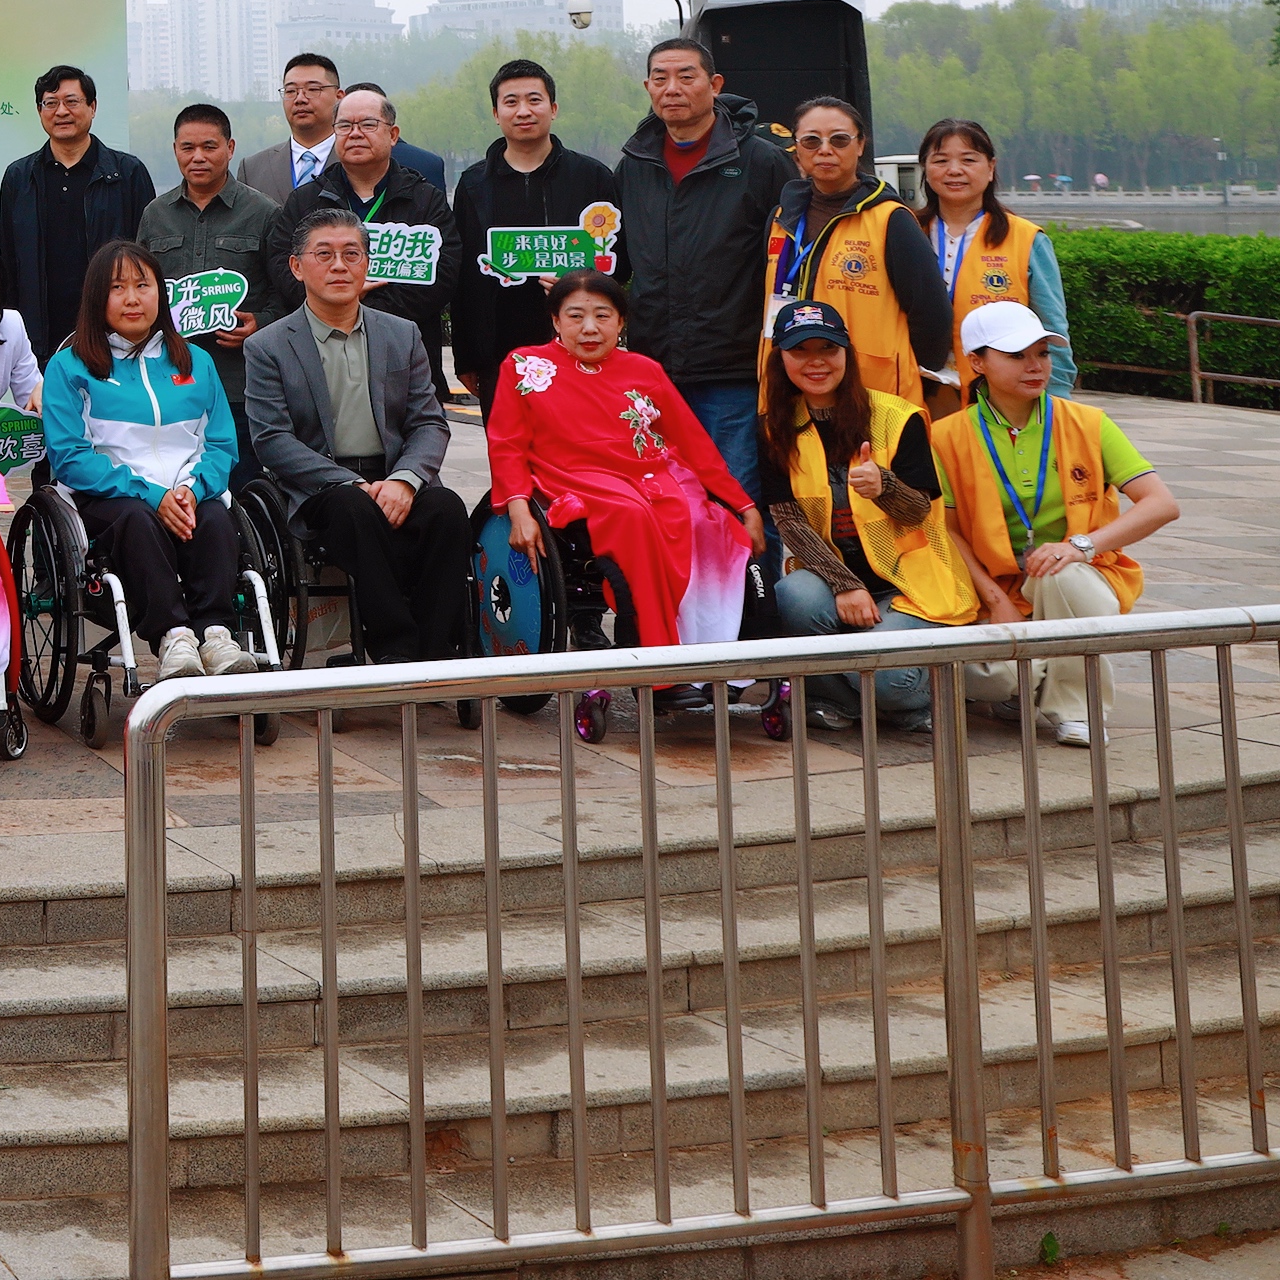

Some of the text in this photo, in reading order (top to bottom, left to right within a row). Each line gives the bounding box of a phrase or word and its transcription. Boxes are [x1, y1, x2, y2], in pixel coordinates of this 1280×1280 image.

[495, 233, 569, 252] 出来真好
[502, 251, 587, 269] 步步是风景
[201, 282, 242, 297] SRRING
[181, 303, 233, 332] 微风
[1, 419, 38, 433] SPRING
